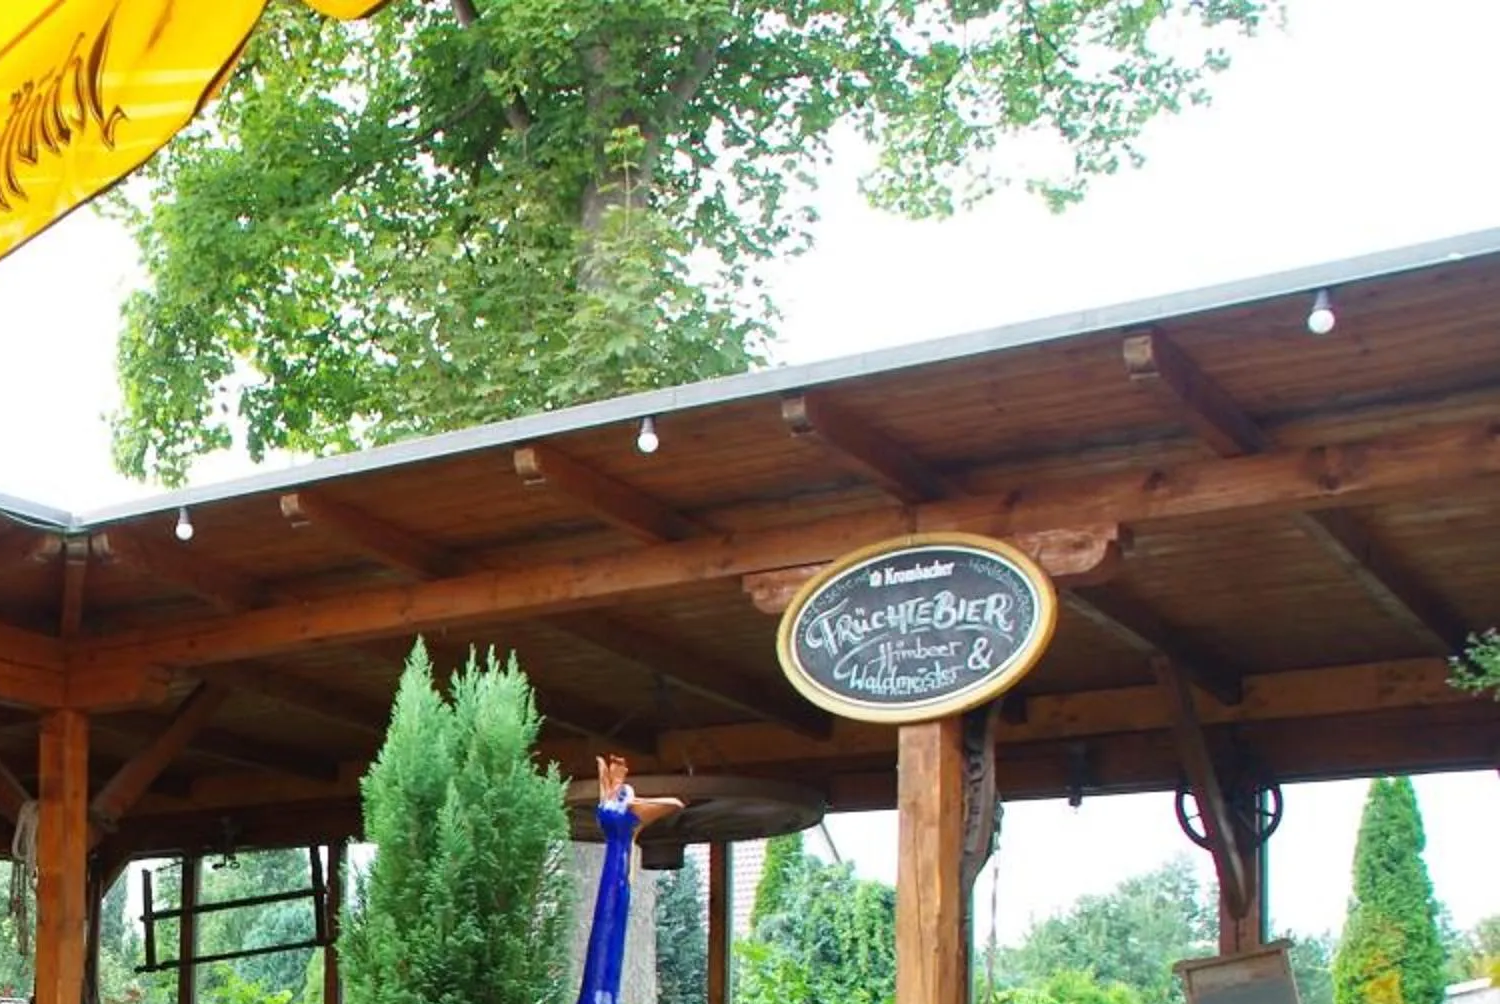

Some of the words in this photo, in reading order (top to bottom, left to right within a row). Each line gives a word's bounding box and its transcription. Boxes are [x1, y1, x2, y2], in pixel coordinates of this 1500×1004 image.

[884, 561, 955, 587] Krombacher
[868, 637, 963, 674] Himbeer
[967, 637, 994, 670] &
[849, 660, 966, 694] Waldmeister
